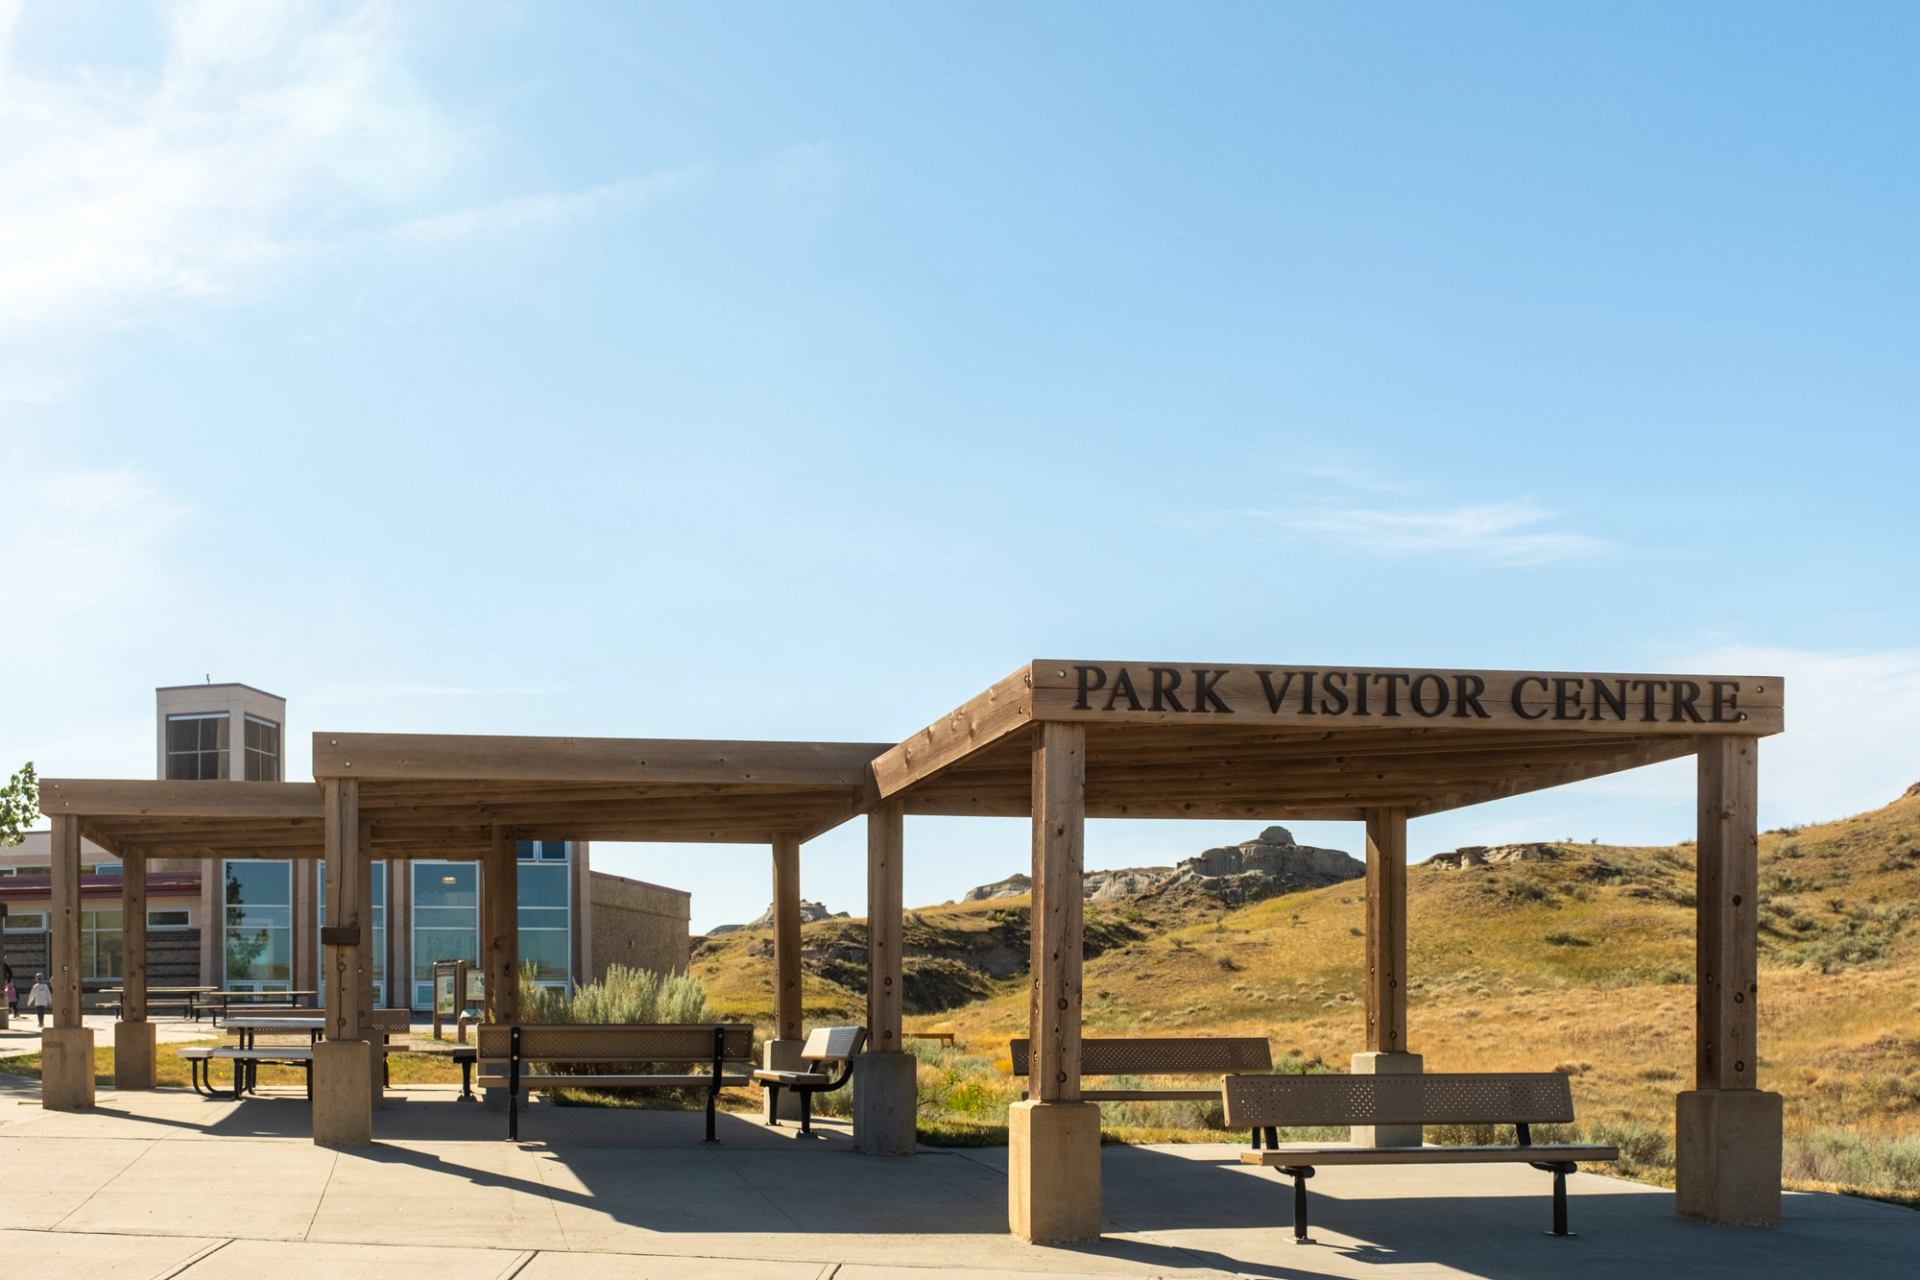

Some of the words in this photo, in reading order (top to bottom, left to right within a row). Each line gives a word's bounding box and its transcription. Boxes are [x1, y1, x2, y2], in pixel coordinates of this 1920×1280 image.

[1073, 665, 1234, 713] PARK
[1255, 670, 1491, 718] VISITOR
[1511, 676, 1742, 723] CENTRE
